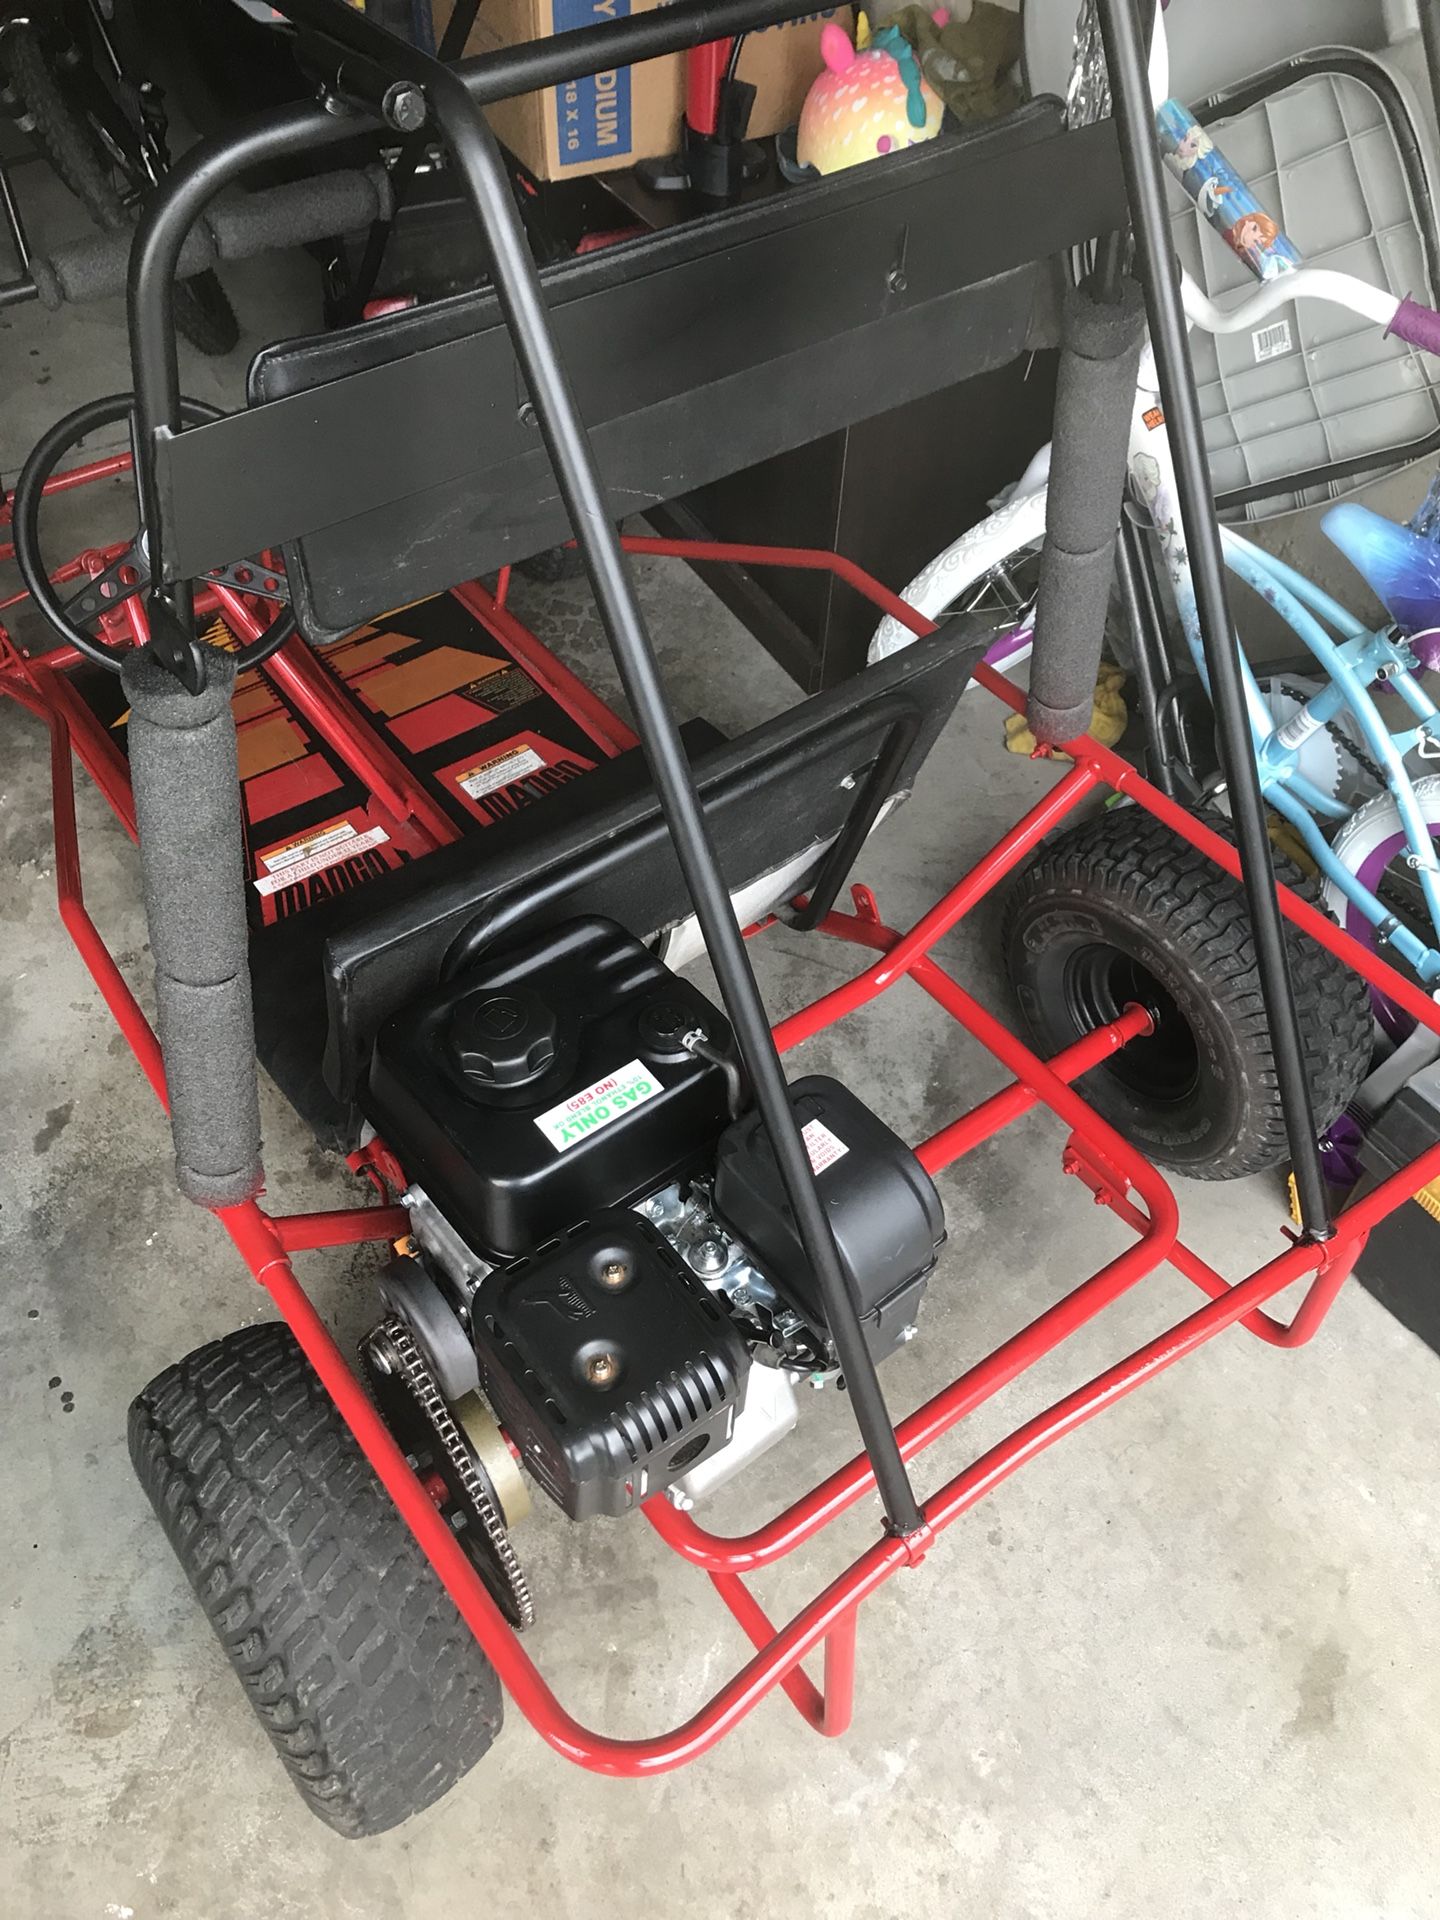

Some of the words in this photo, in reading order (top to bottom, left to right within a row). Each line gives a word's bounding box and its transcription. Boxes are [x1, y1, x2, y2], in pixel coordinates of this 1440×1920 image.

[595, 69, 618, 146] DIUM
[567, 128, 580, 150] 16
[479, 748, 518, 770] WARNING
[292, 829, 325, 847] WARNING
[591, 1083, 626, 1107] ETHANOL
[593, 1077, 617, 1096] (NO
[611, 1078, 652, 1111] GAS
[565, 1091, 594, 1113] E85)
[557, 1103, 611, 1143] ONLY
[565, 1105, 591, 1123] BLEND
